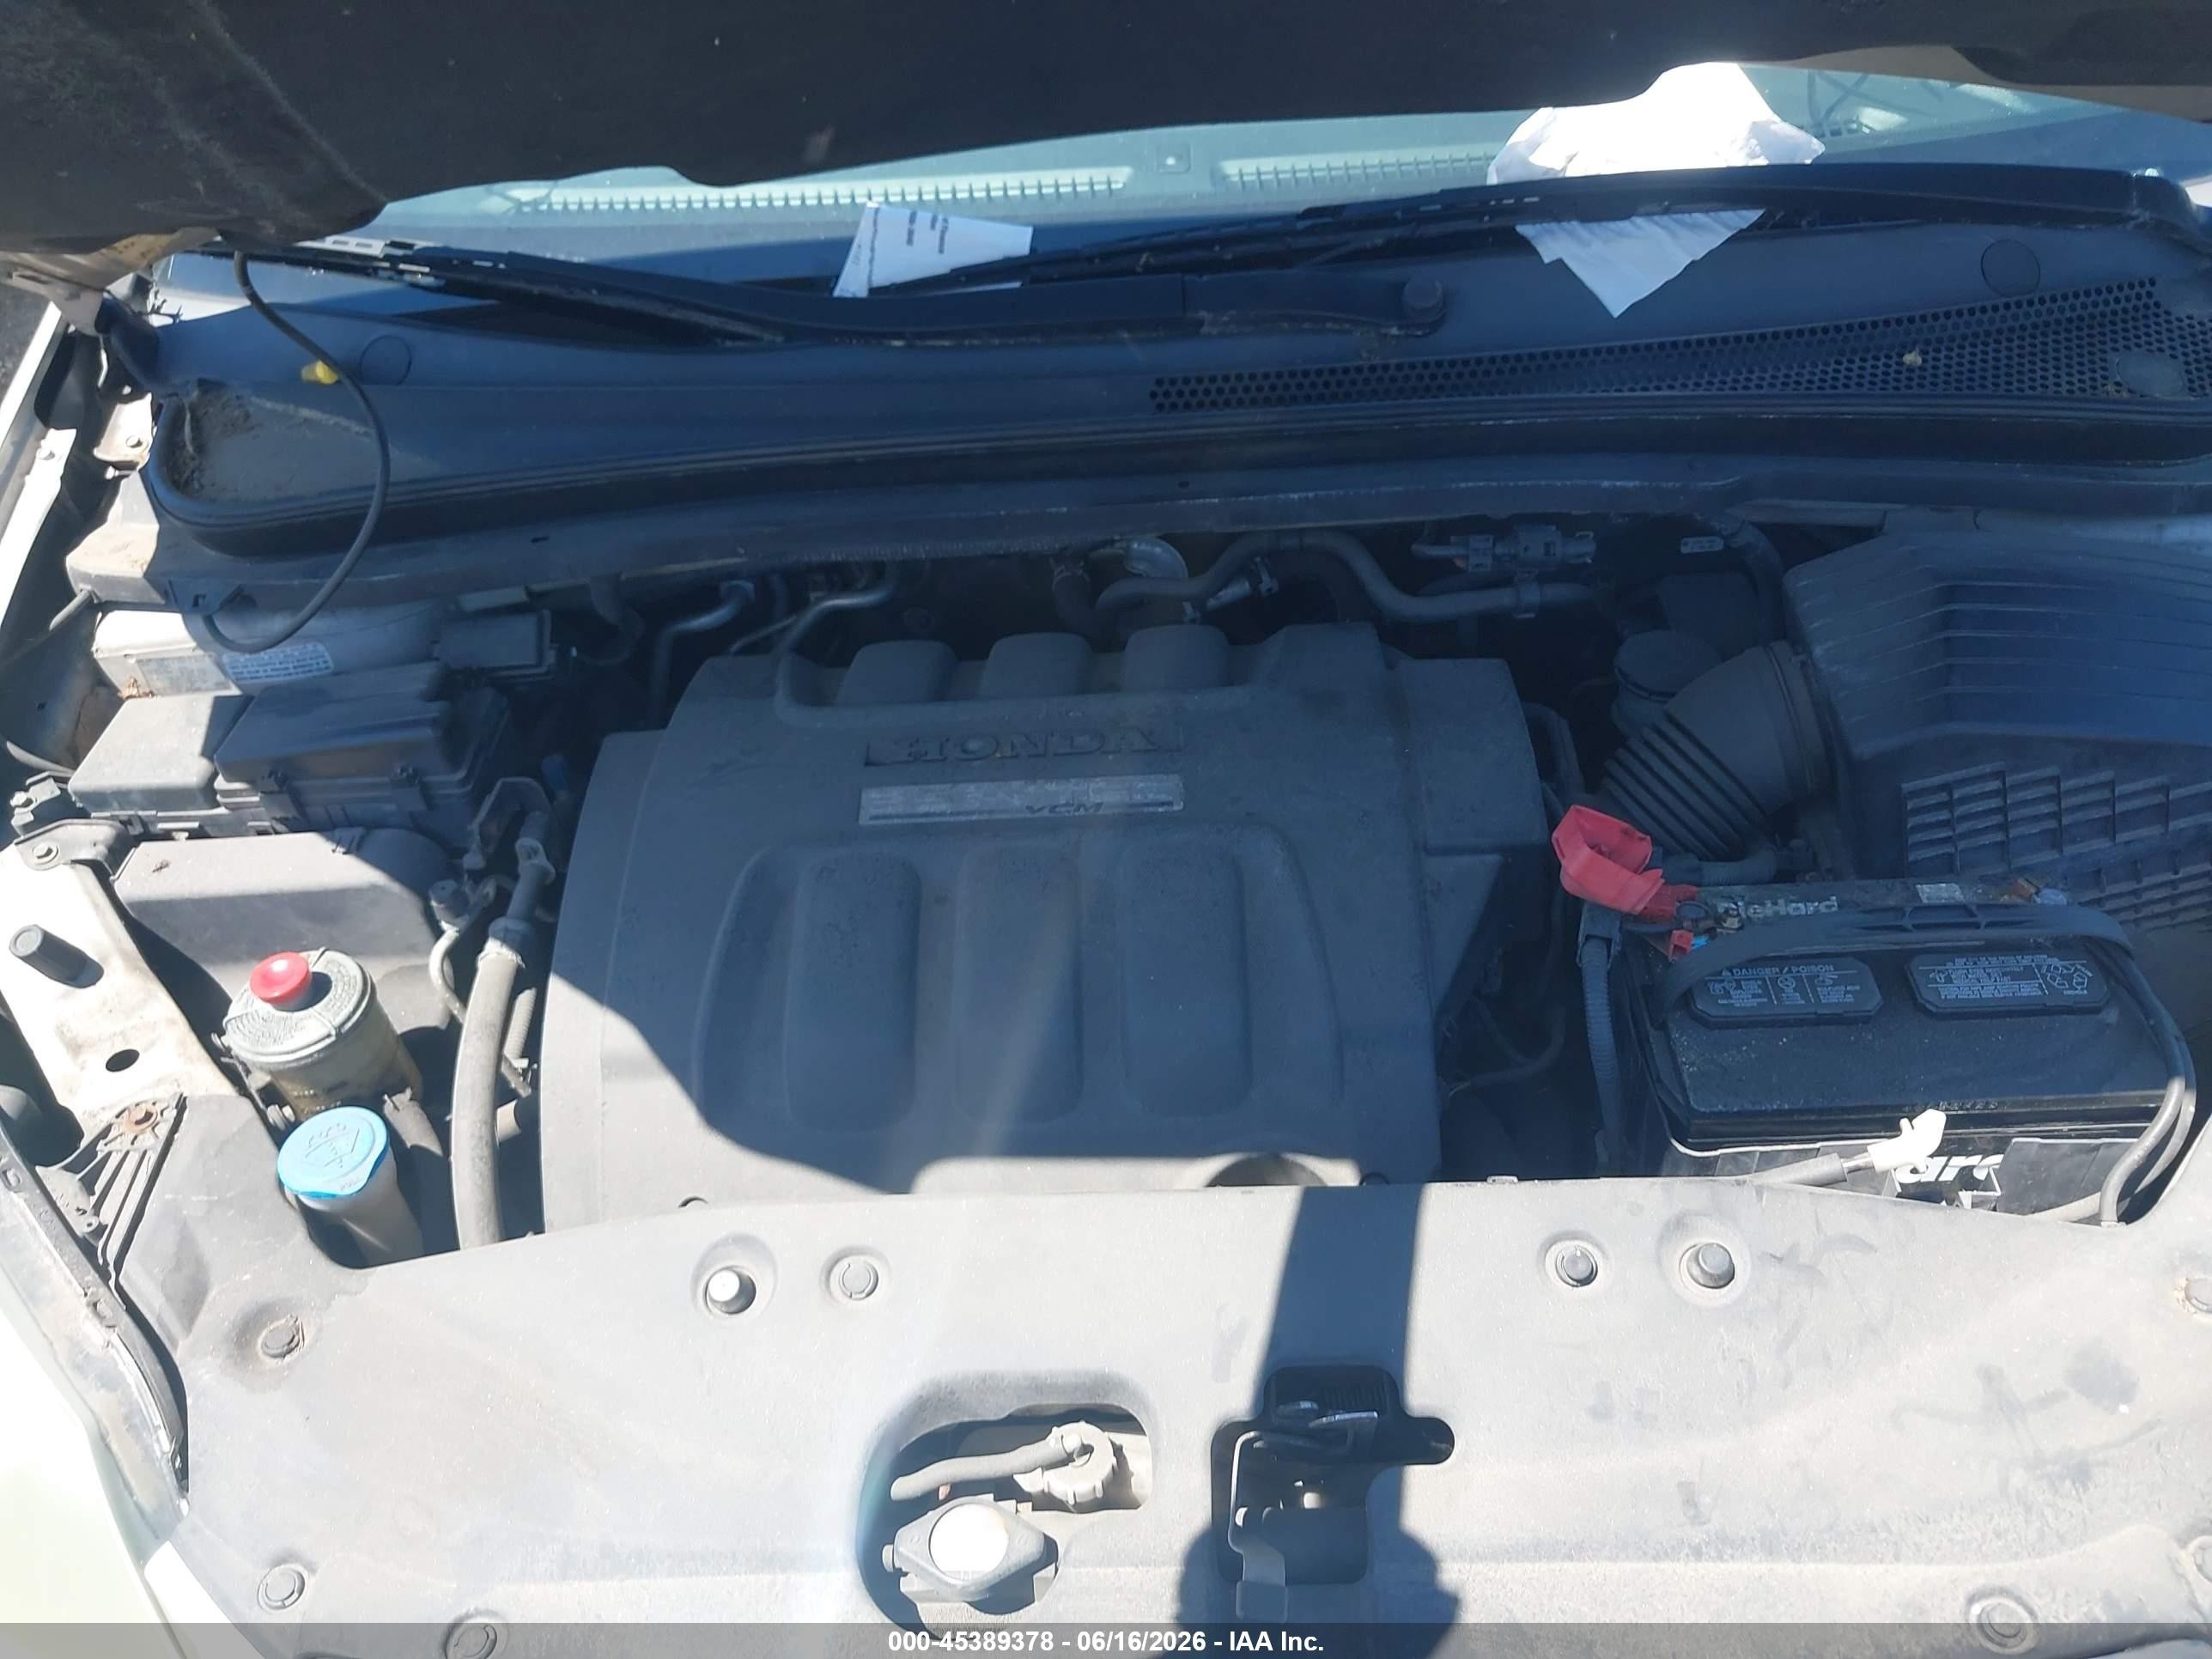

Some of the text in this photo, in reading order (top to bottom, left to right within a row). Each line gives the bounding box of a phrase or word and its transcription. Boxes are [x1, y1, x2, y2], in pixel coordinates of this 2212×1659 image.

[895, 728, 1161, 763] HONDA
[1733, 966, 1781, 977] DANGER
[1791, 963, 1835, 974] POISON
